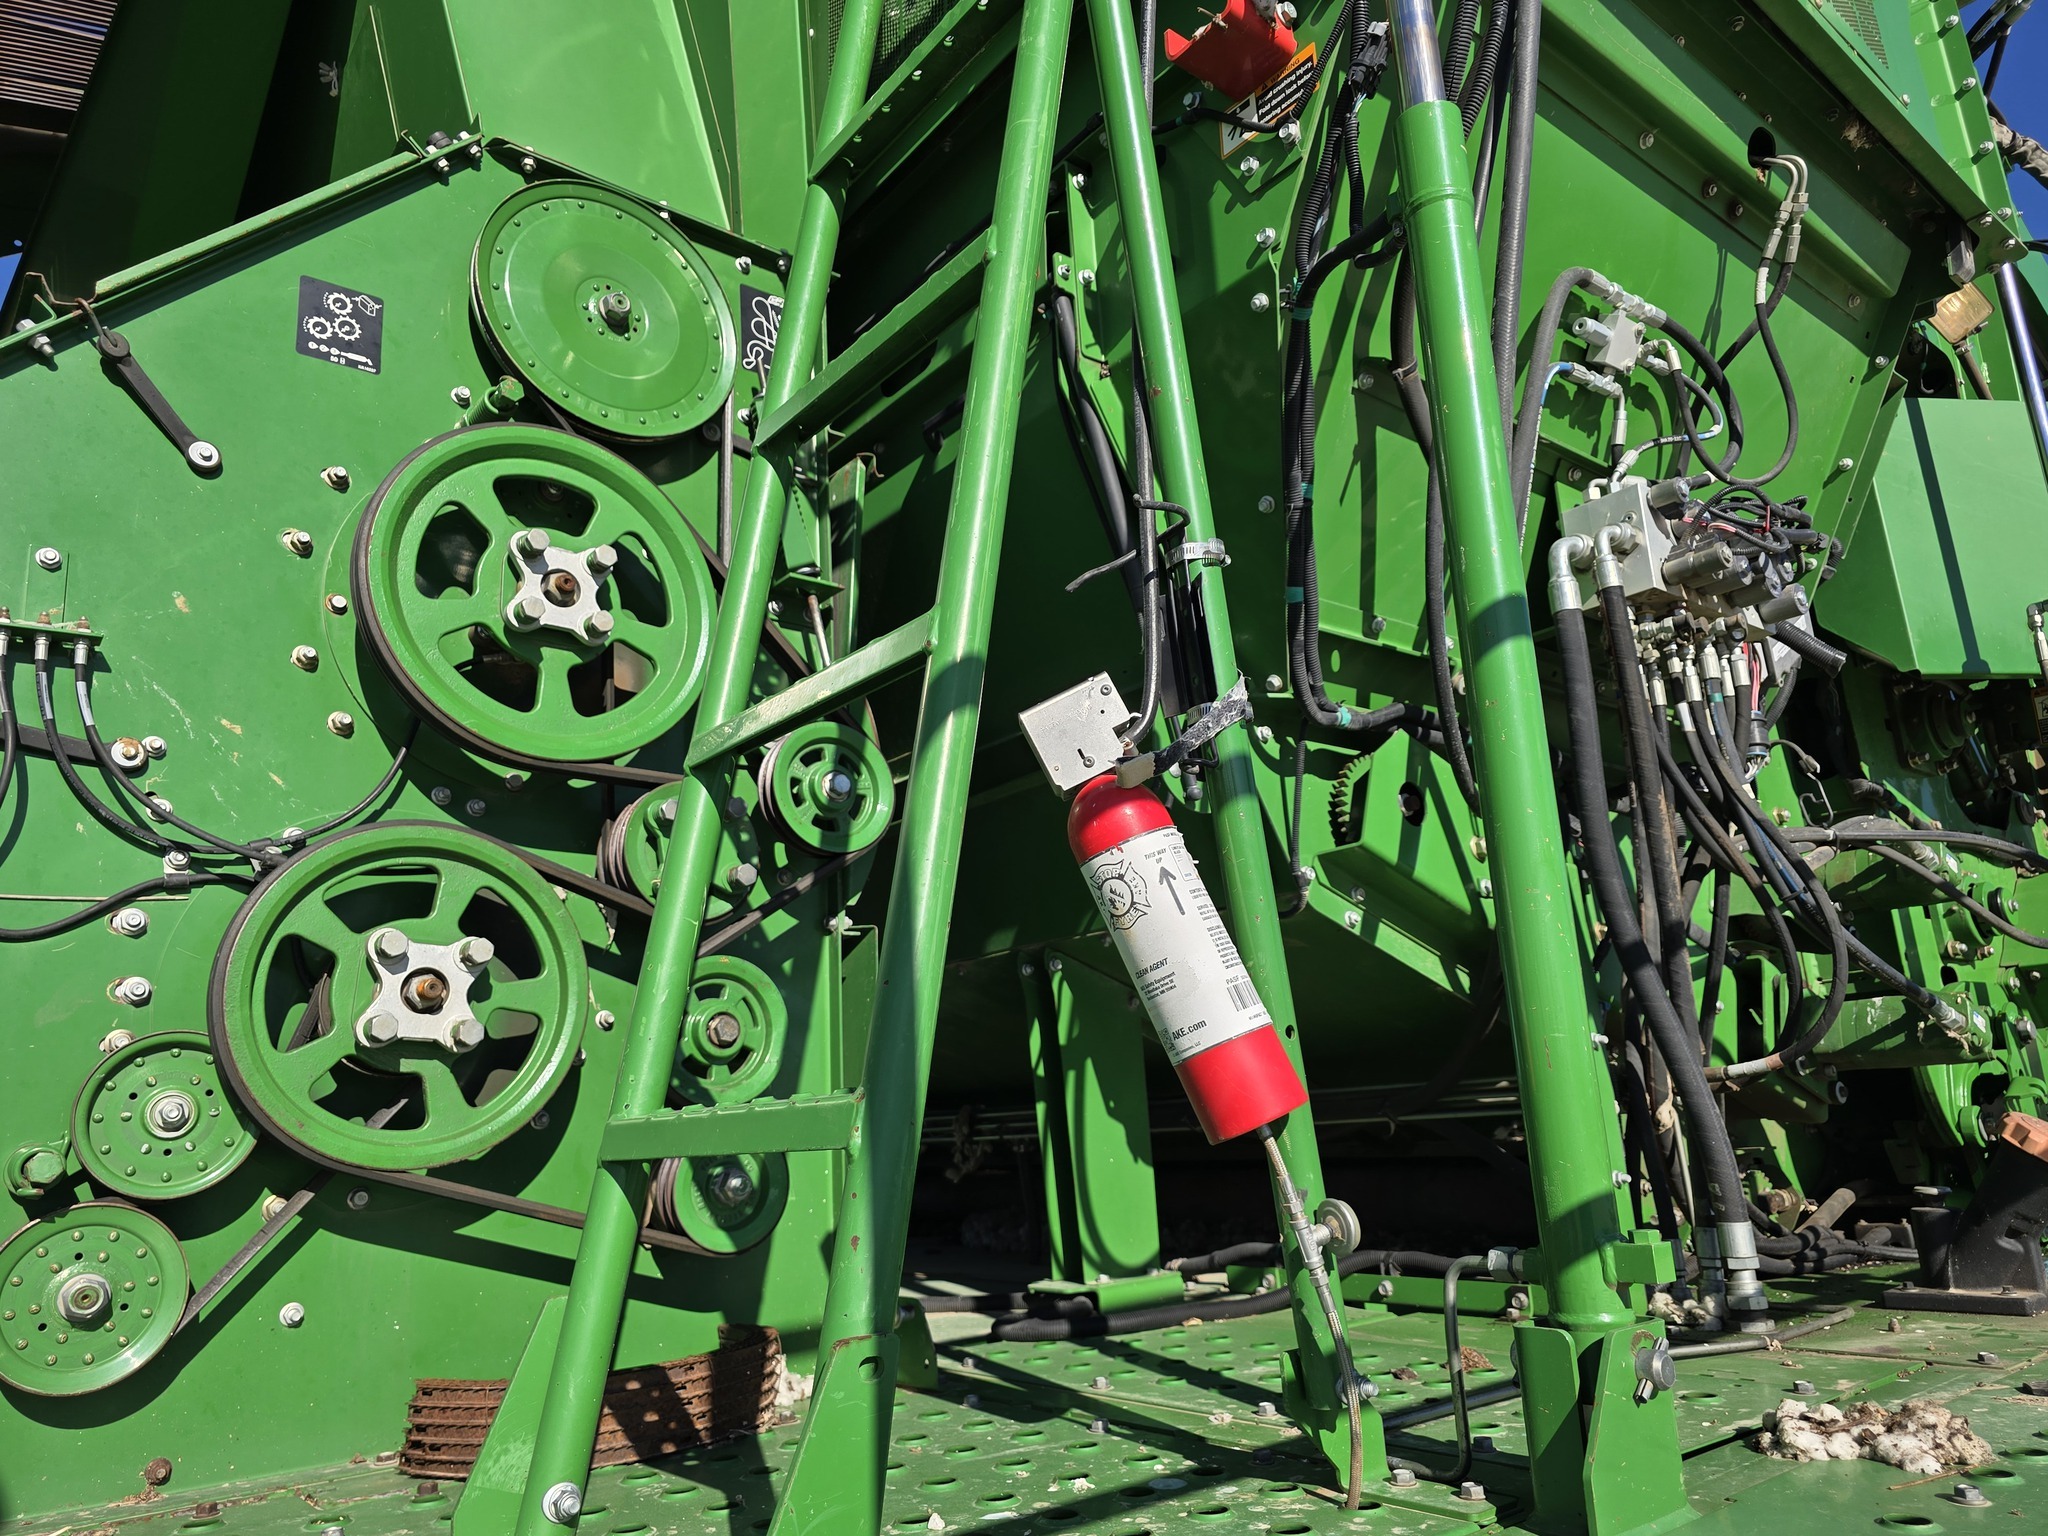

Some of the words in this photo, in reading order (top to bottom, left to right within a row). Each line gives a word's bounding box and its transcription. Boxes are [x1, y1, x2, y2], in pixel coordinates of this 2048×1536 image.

[1258, 90, 1273, 105] Avoid
[1273, 73, 1296, 94] crushing
[1259, 102, 1271, 115] Fold
[1271, 92, 1286, 106] down
[1144, 851, 1156, 860] THIS
[1156, 848, 1167, 856] WAY
[1095, 867, 1120, 887] STOP
[1113, 905, 1140, 927] FYRE
[1149, 957, 1168, 973] AGENT
[1172, 1020, 1208, 1041] AKE.com
